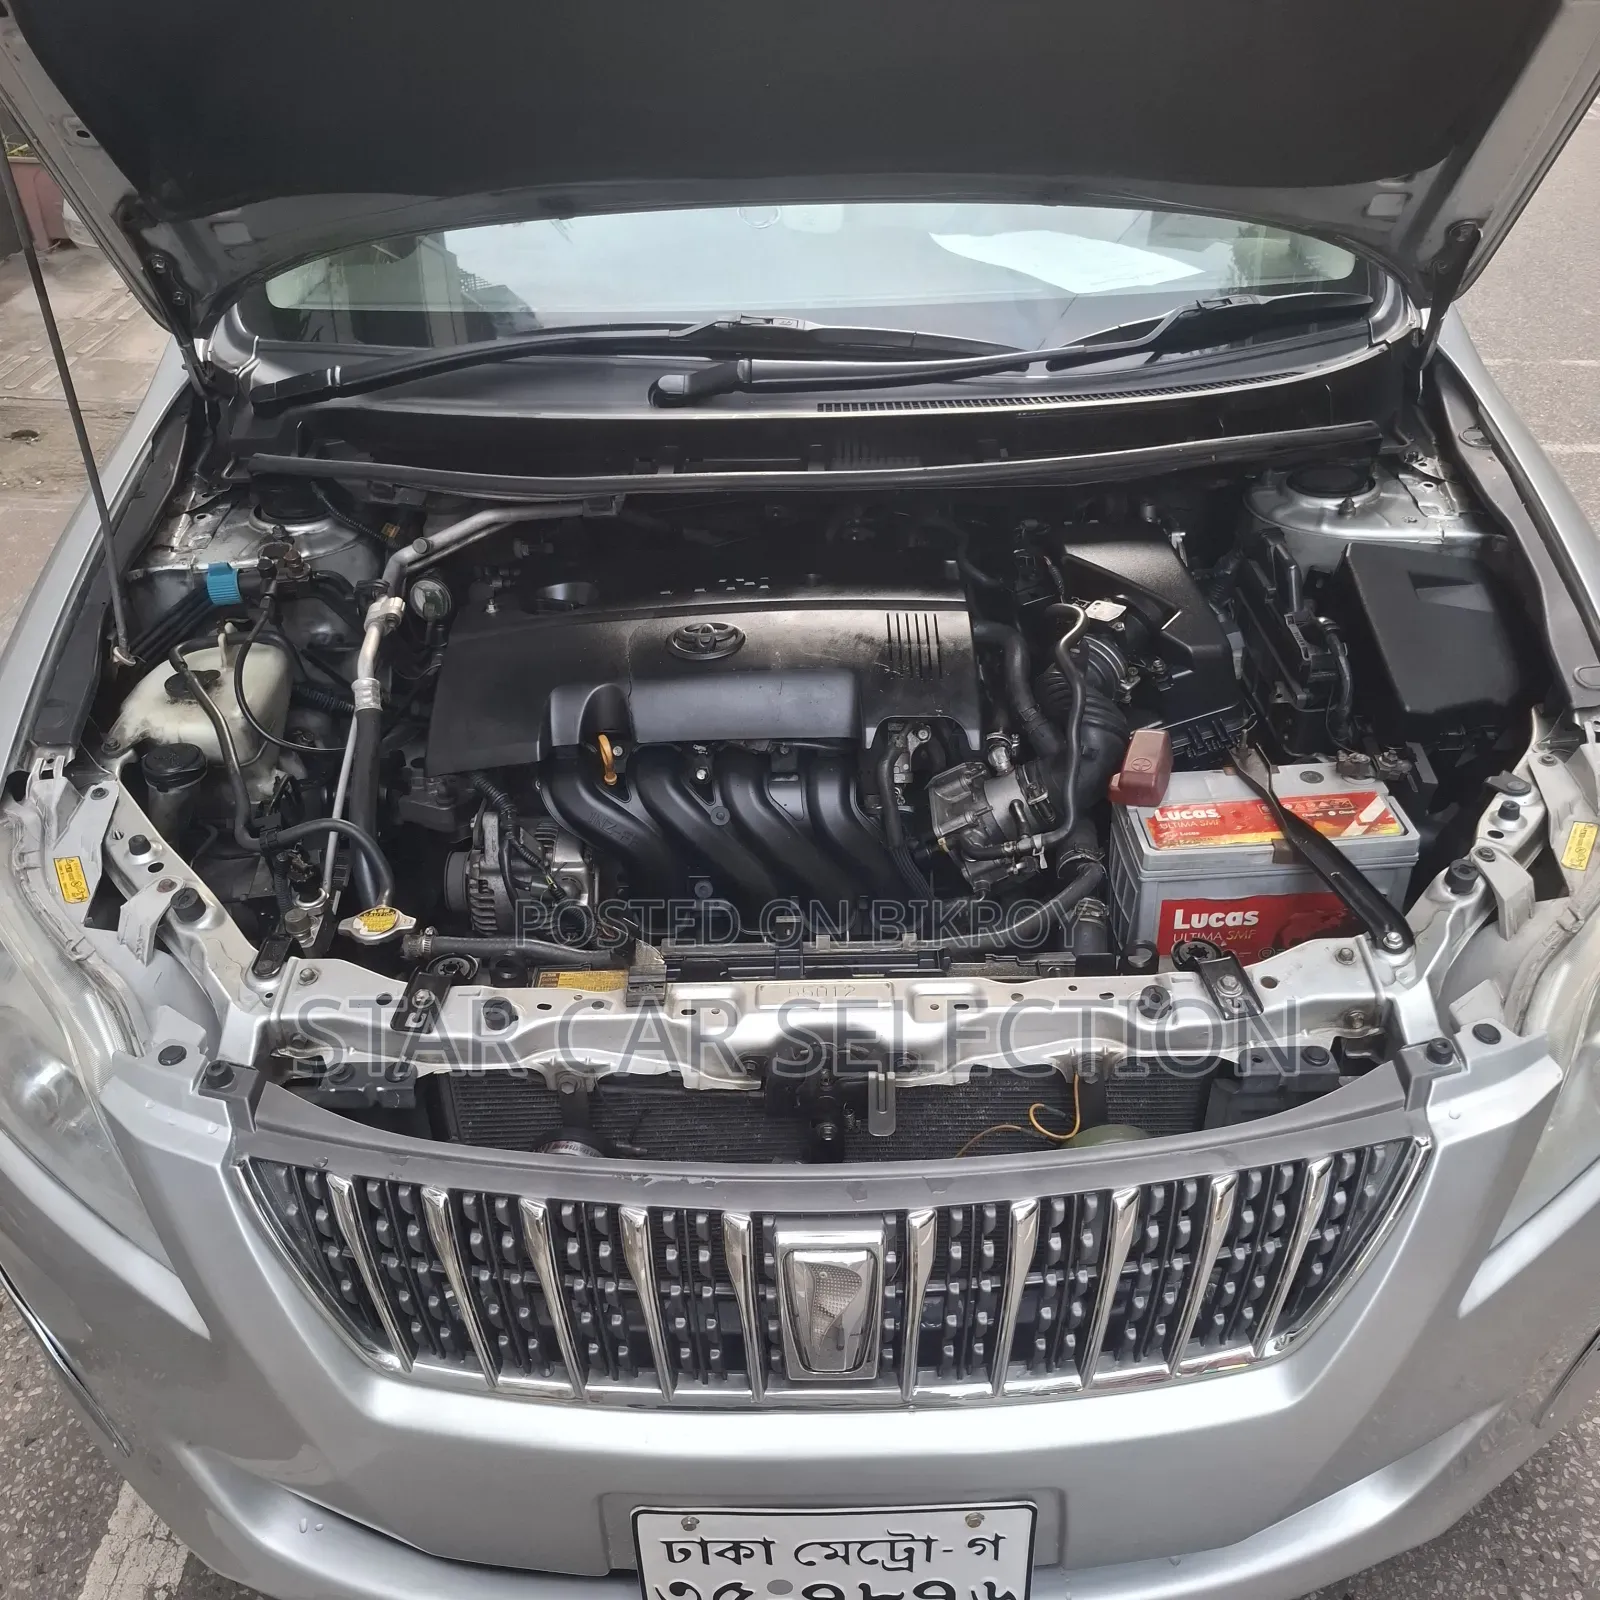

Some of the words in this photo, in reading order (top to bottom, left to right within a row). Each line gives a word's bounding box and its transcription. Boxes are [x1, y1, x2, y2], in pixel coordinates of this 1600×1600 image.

[1154, 808, 1219, 822] Lucas
[1159, 820, 1198, 830] ULTIMA
[1173, 908, 1259, 930] Lucas
[1226, 929, 1257, 941] SMF
[660, 1535, 777, 1565] ঢাকা
